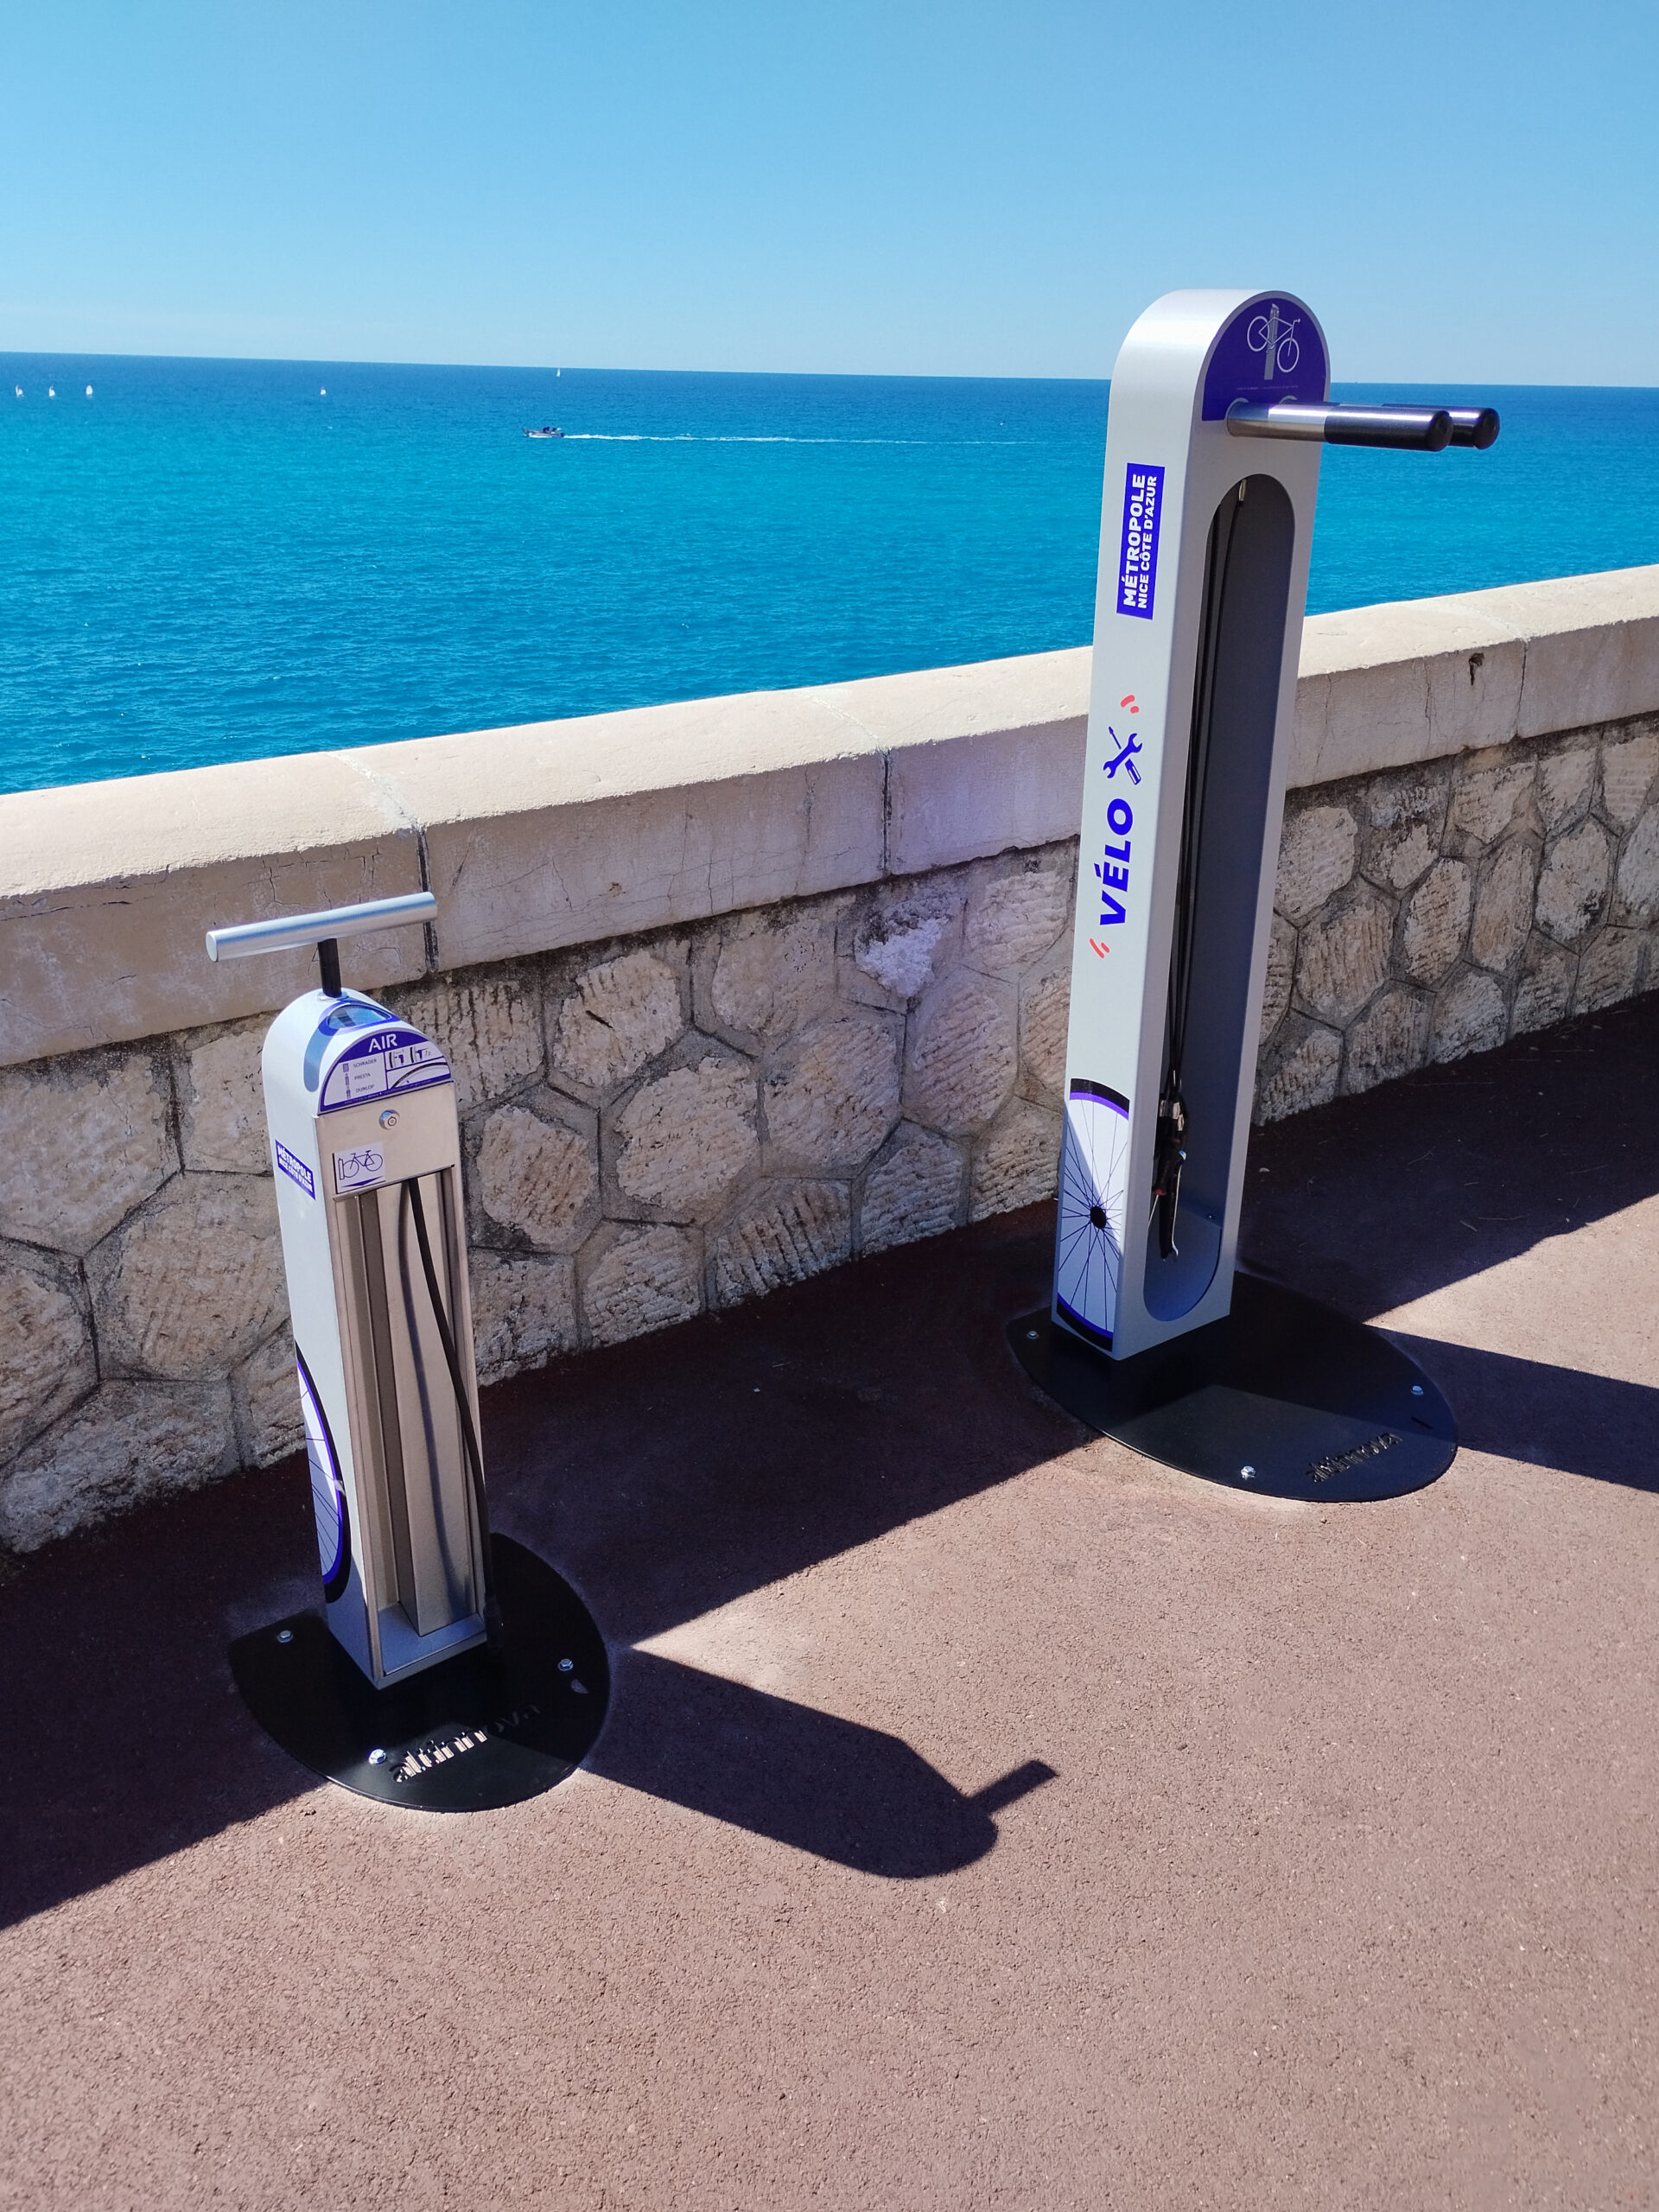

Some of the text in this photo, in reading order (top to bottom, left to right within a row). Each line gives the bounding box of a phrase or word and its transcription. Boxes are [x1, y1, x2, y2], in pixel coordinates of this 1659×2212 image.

[1122, 474, 1146, 607] MÉTROPOLE
[1137, 476, 1157, 609] NICE CÔTE D'AZUR
[1094, 798, 1133, 925] VÉLO
[368, 1033, 398, 1052] AIR
[353, 1058, 378, 1068] SCHRADER
[354, 1071, 372, 1080] PRESTA
[355, 1084, 375, 1093] DUNLOP
